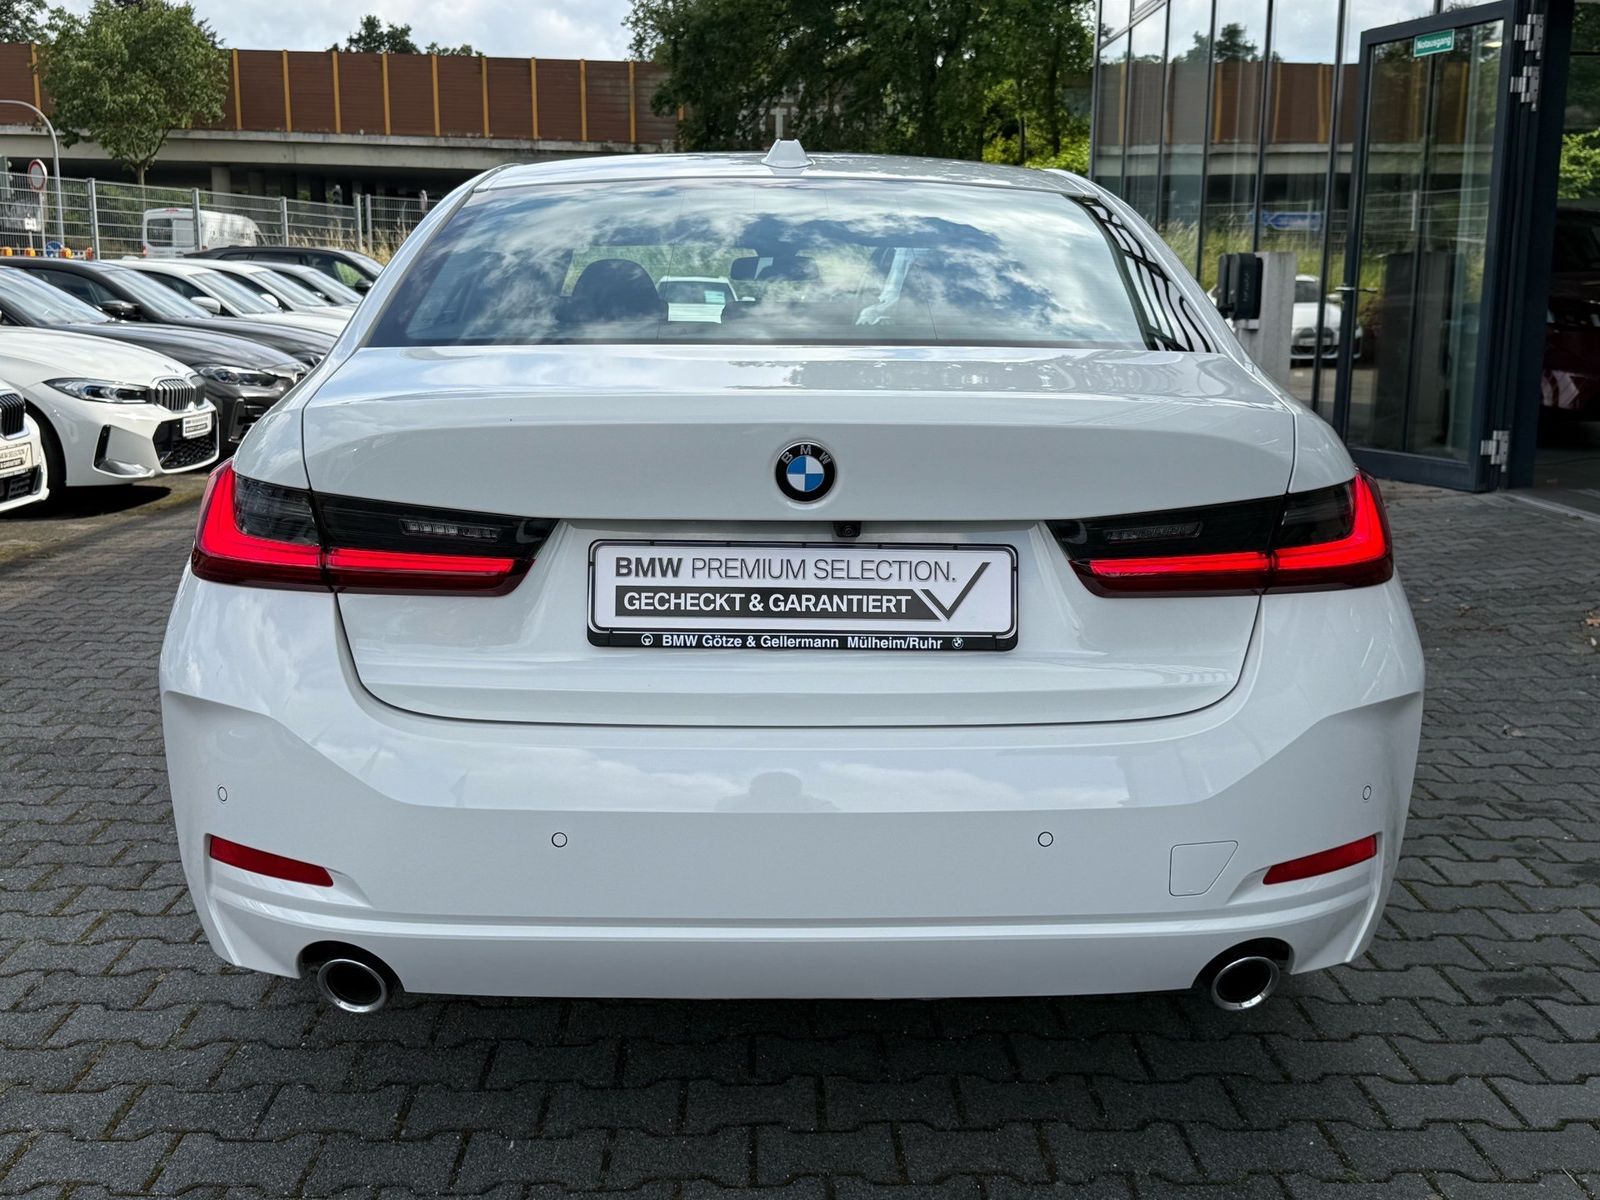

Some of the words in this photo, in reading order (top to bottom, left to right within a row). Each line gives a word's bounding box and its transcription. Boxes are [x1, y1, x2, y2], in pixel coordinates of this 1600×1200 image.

[780, 444, 831, 465] BMW
[615, 556, 683, 578] BMW
[691, 557, 806, 579] PREMIUM
[813, 558, 957, 582] SELECTION.
[623, 592, 746, 611] GECHECKT
[748, 593, 764, 612] &
[768, 593, 912, 613] GARANTIERT
[662, 634, 698, 647] BMW
[702, 634, 742, 648] Götze
[746, 635, 757, 648] &
[760, 635, 839, 649] Gellermann
[847, 636, 943, 650] Mülheim/Ruhr
